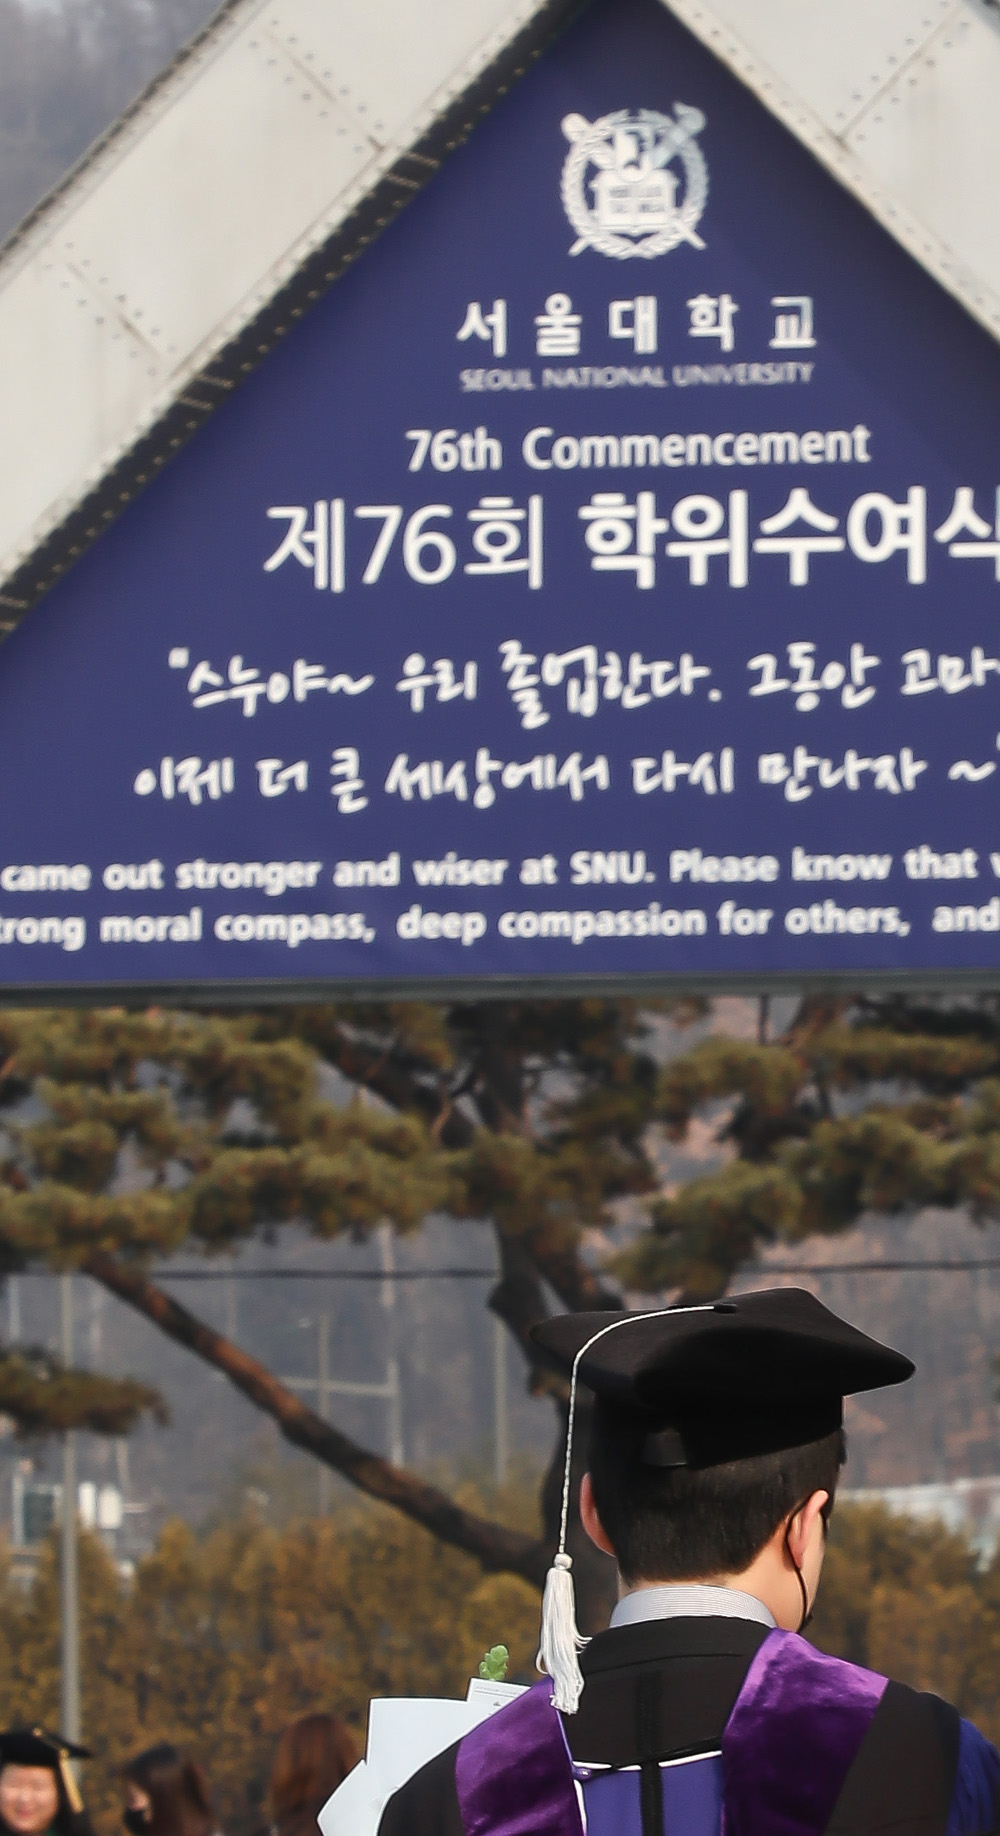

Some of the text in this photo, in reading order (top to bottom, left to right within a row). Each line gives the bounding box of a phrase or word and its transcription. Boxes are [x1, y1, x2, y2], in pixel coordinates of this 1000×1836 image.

[456, 291, 818, 358] 서울대학교
[459, 361, 816, 393] SEOUL NATIONAL UNIVERSITY
[405, 424, 871, 473] 76th Commencement
[262, 494, 544, 594] 제76회
[395, 652, 478, 713] 우리
[498, 639, 723, 730] 졸업한다.
[746, 641, 881, 712] 그동안
[133, 756, 235, 806] 이제
[255, 758, 309, 798] 더
[329, 746, 369, 814] 큰
[384, 747, 610, 810] 세상에서
[630, 746, 735, 796] 다시
[1, 864, 92, 892] came
[102, 858, 165, 891] out
[175, 858, 322, 896] stronger
[332, 851, 401, 888] and
[412, 851, 509, 887] wiser
[518, 853, 558, 886] at
[569, 850, 657, 885] SNU.
[669, 847, 780, 884] Please
[791, 846, 893, 882] know
[902, 844, 979, 880] that
[99, 906, 203, 943] moral
[213, 910, 376, 949] compass,
[395, 903, 488, 947] deep
[497, 901, 708, 946] compassion
[715, 899, 774, 936] for
[784, 898, 911, 938] others,
